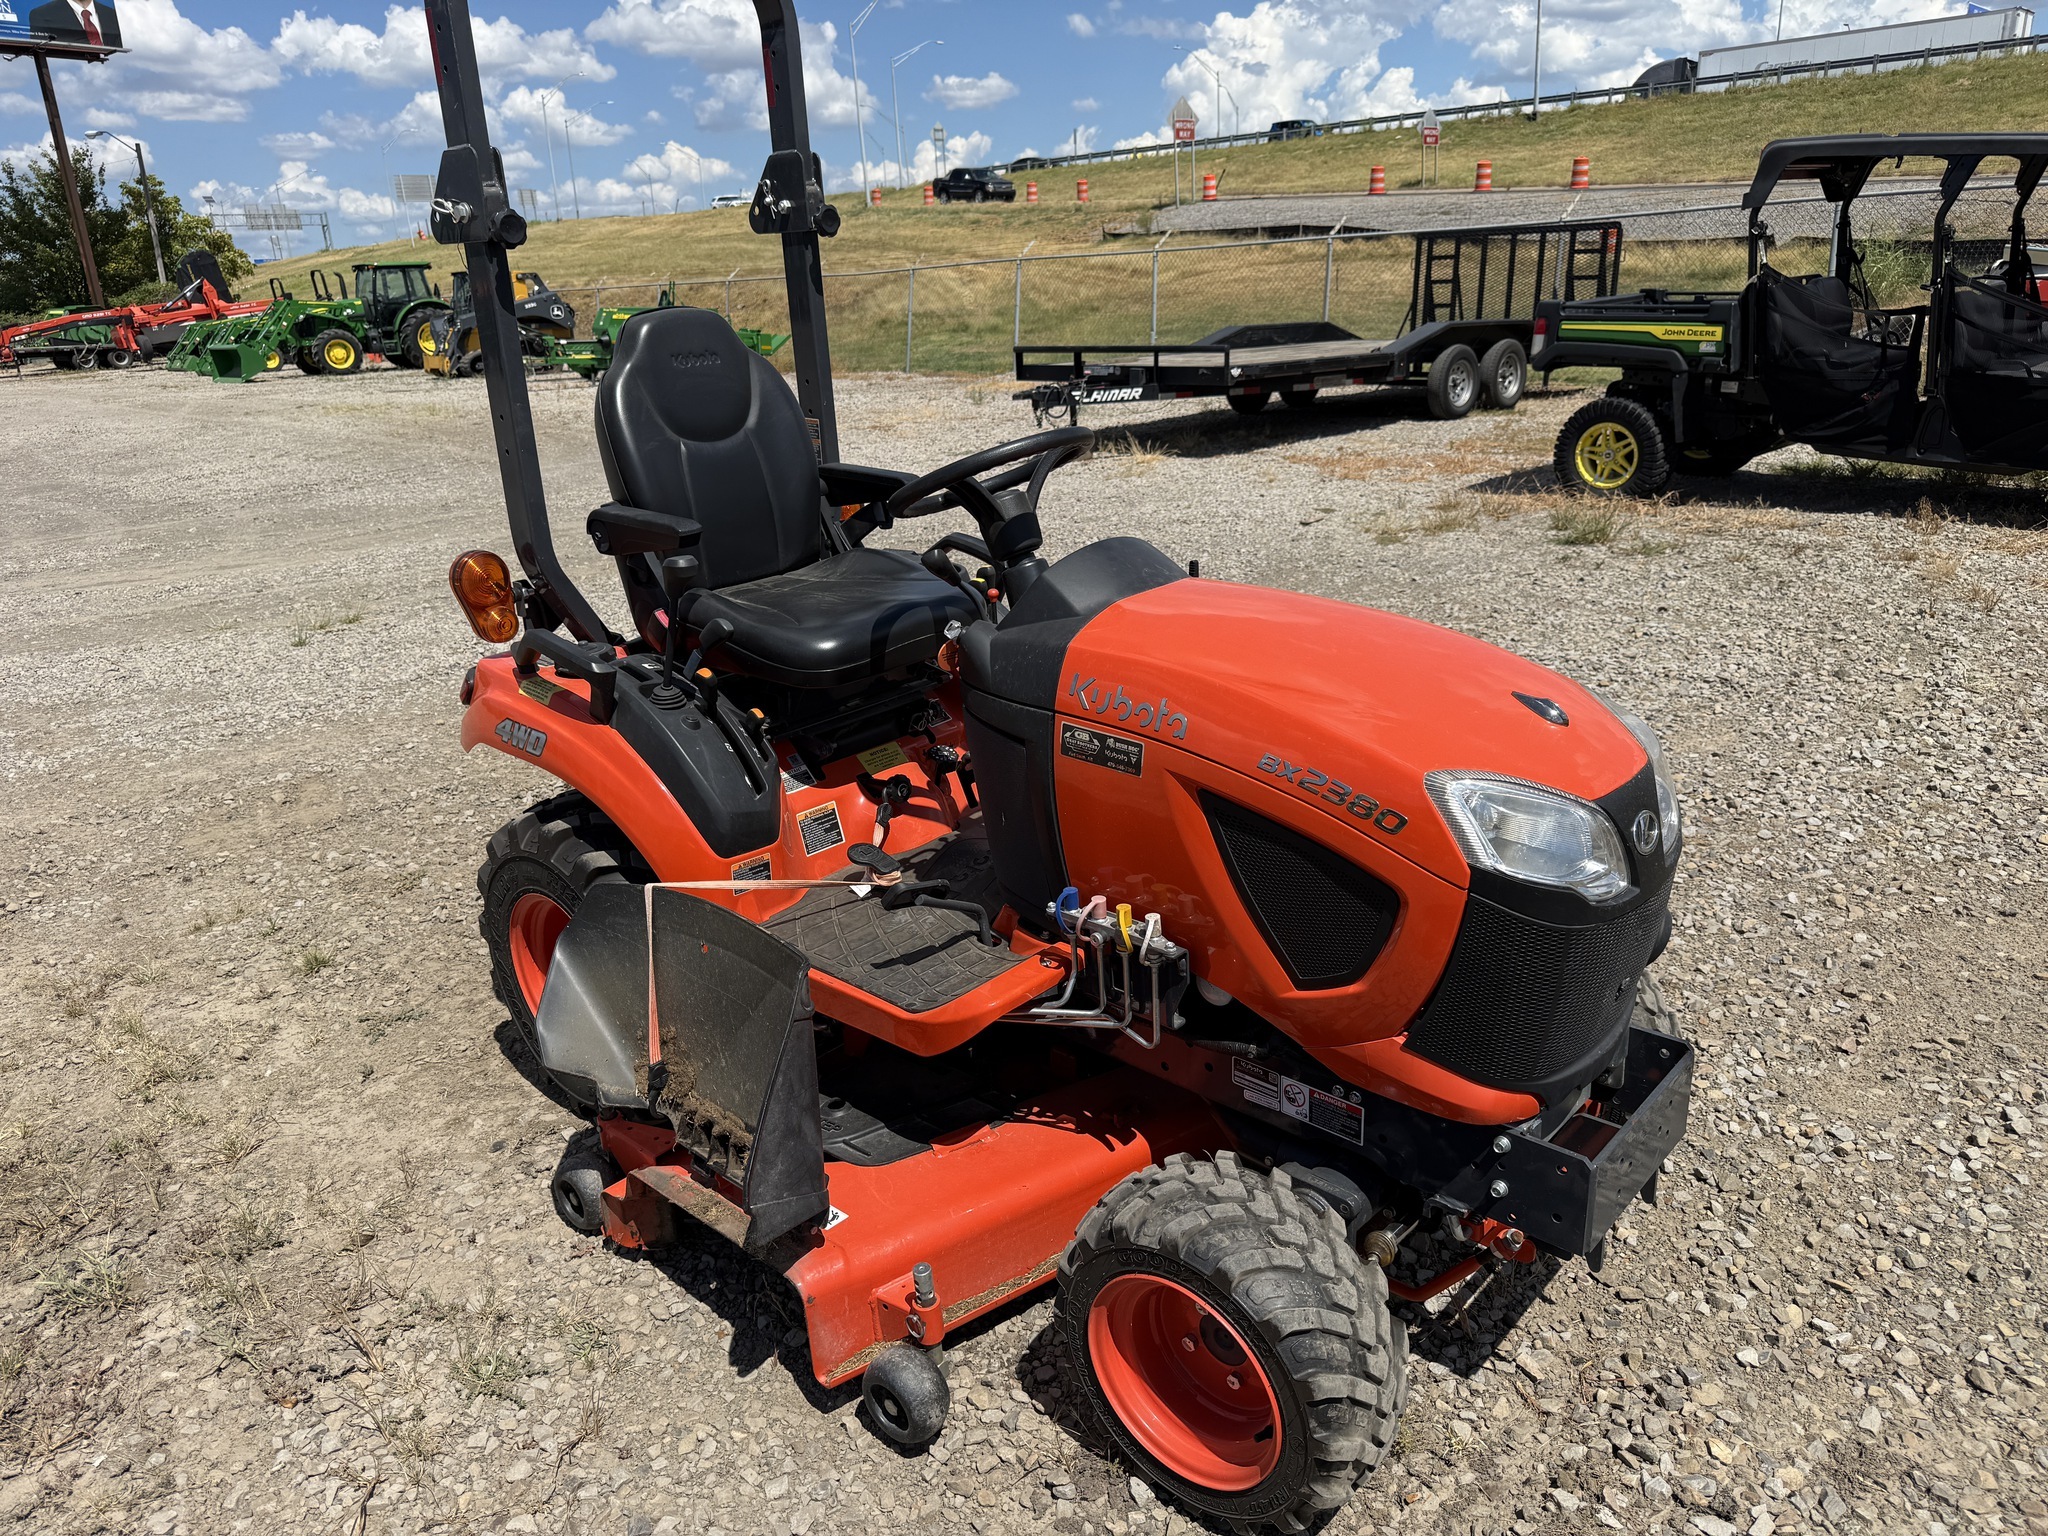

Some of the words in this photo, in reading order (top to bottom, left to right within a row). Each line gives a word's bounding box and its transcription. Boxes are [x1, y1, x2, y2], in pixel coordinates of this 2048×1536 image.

[1175, 121, 1195, 129] WRONG
[1179, 130, 1191, 138] WAY
[1661, 328, 1686, 337] JOHN
[1686, 328, 1717, 337] DEERE
[671, 349, 721, 369] Kubota
[1068, 672, 1188, 740] Kubota
[495, 717, 548, 757] 4WD
[1256, 752, 1409, 836] BX2380
[808, 805, 829, 816] WARNING
[742, 855, 765, 868] WARNING
[1320, 1093, 1348, 1110] DANGER
